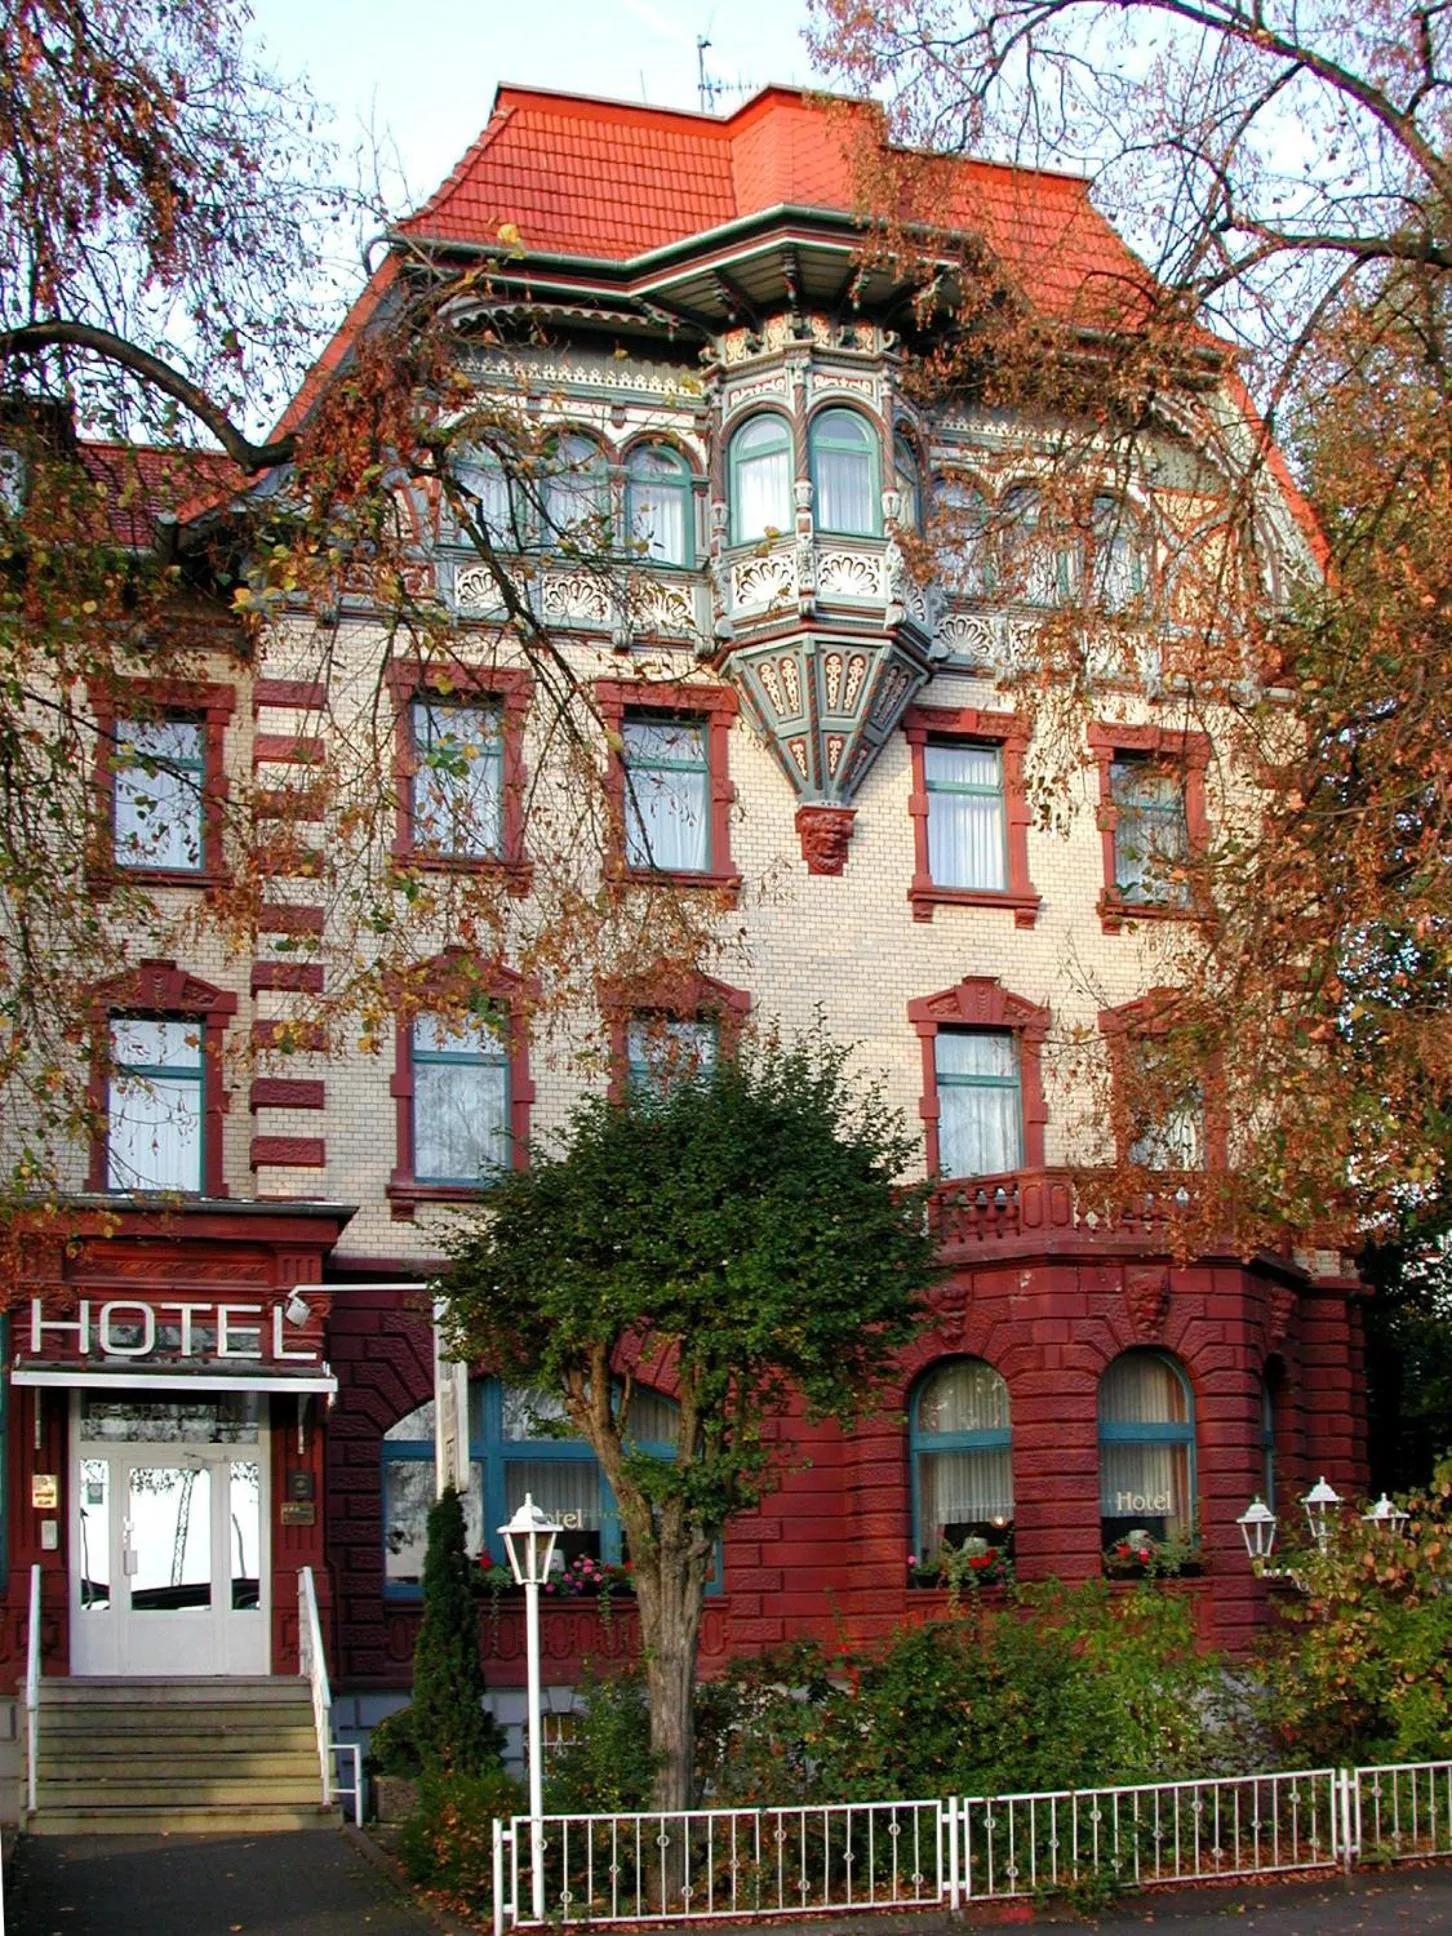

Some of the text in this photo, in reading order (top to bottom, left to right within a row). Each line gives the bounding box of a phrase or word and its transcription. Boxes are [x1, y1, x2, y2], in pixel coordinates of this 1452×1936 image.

[31, 1298, 317, 1360] HOTEL
[1116, 1490, 1171, 1511] Hotel
[545, 1508, 583, 1529] otel
